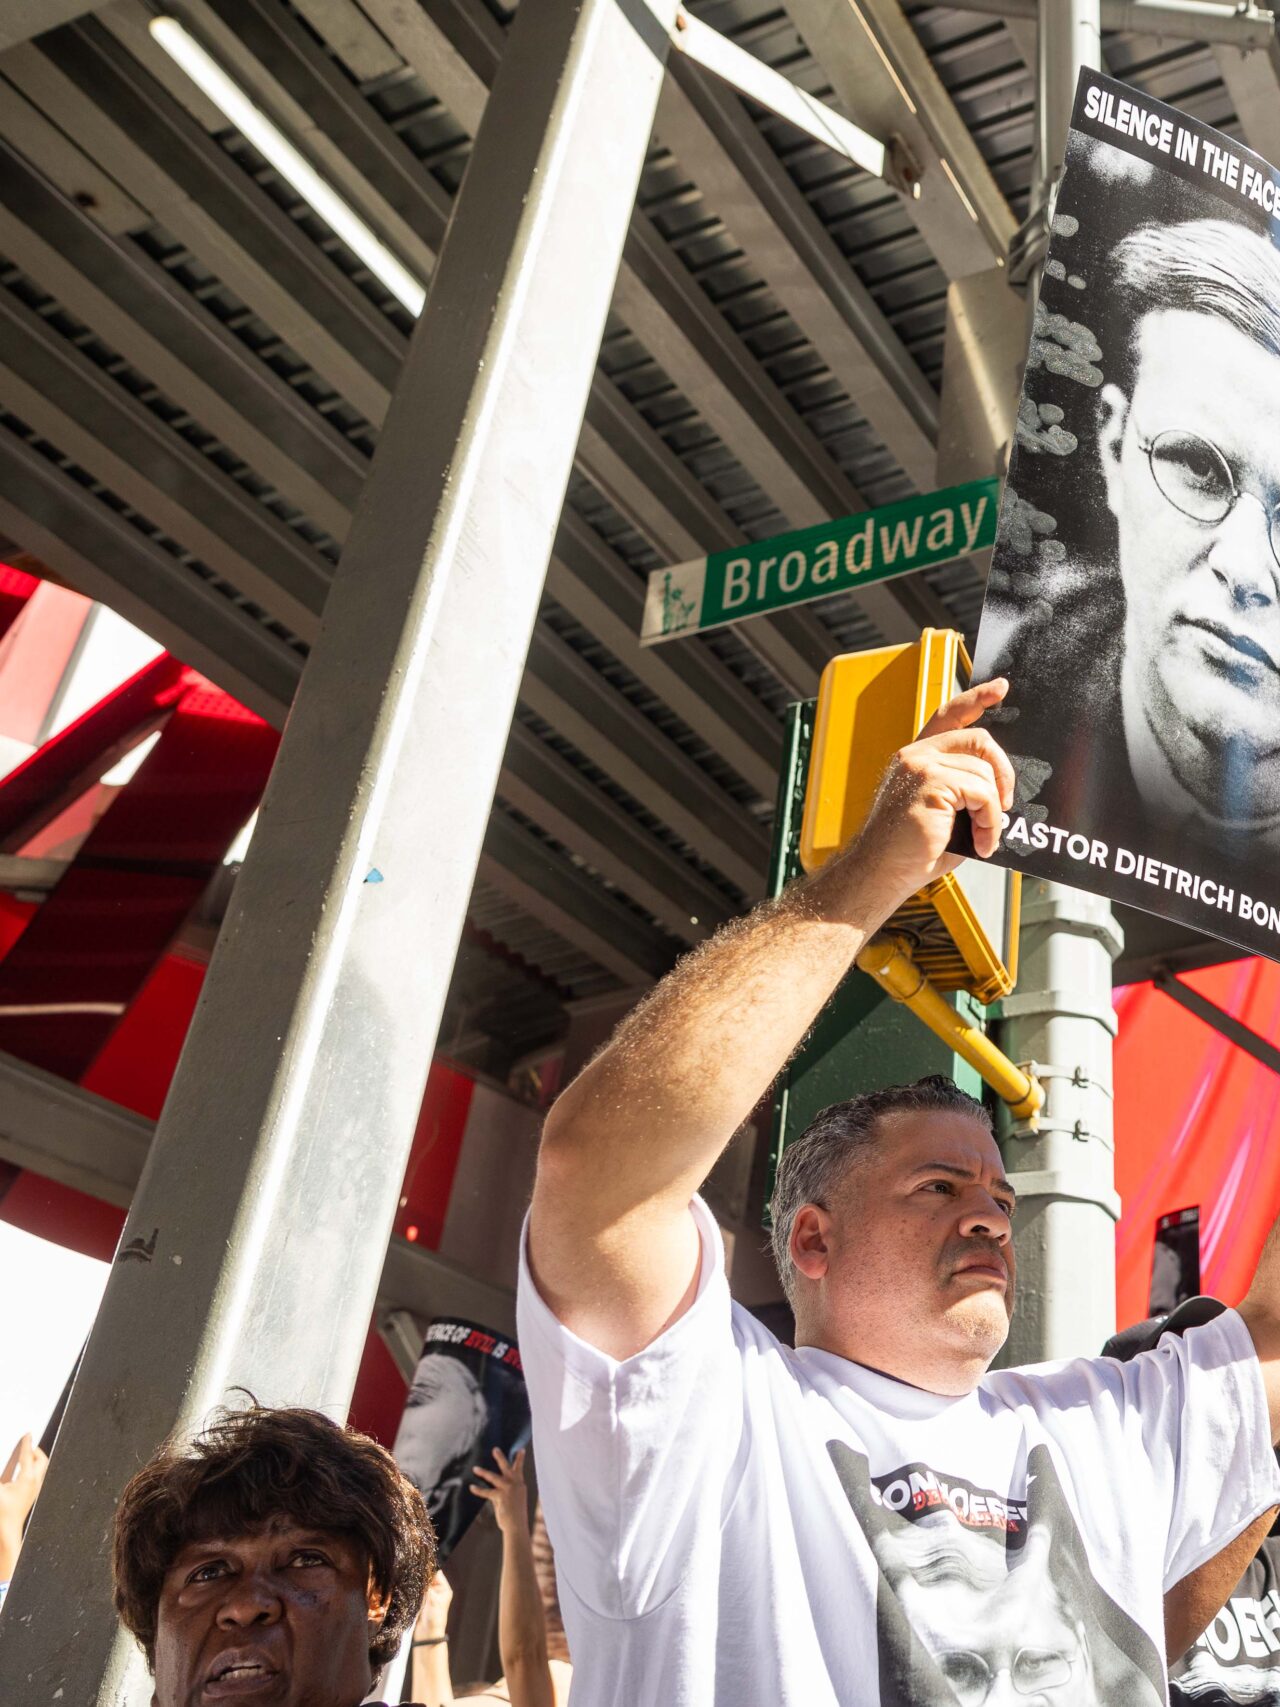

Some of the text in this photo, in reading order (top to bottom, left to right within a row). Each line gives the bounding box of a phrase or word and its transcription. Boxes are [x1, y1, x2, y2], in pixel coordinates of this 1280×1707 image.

[1084, 86, 1174, 152] SILENCE
[1175, 128, 1199, 167] IN
[1202, 140, 1241, 190] THE
[722, 496, 989, 610] Broadway
[1114, 847, 1235, 914] DIETRICH
